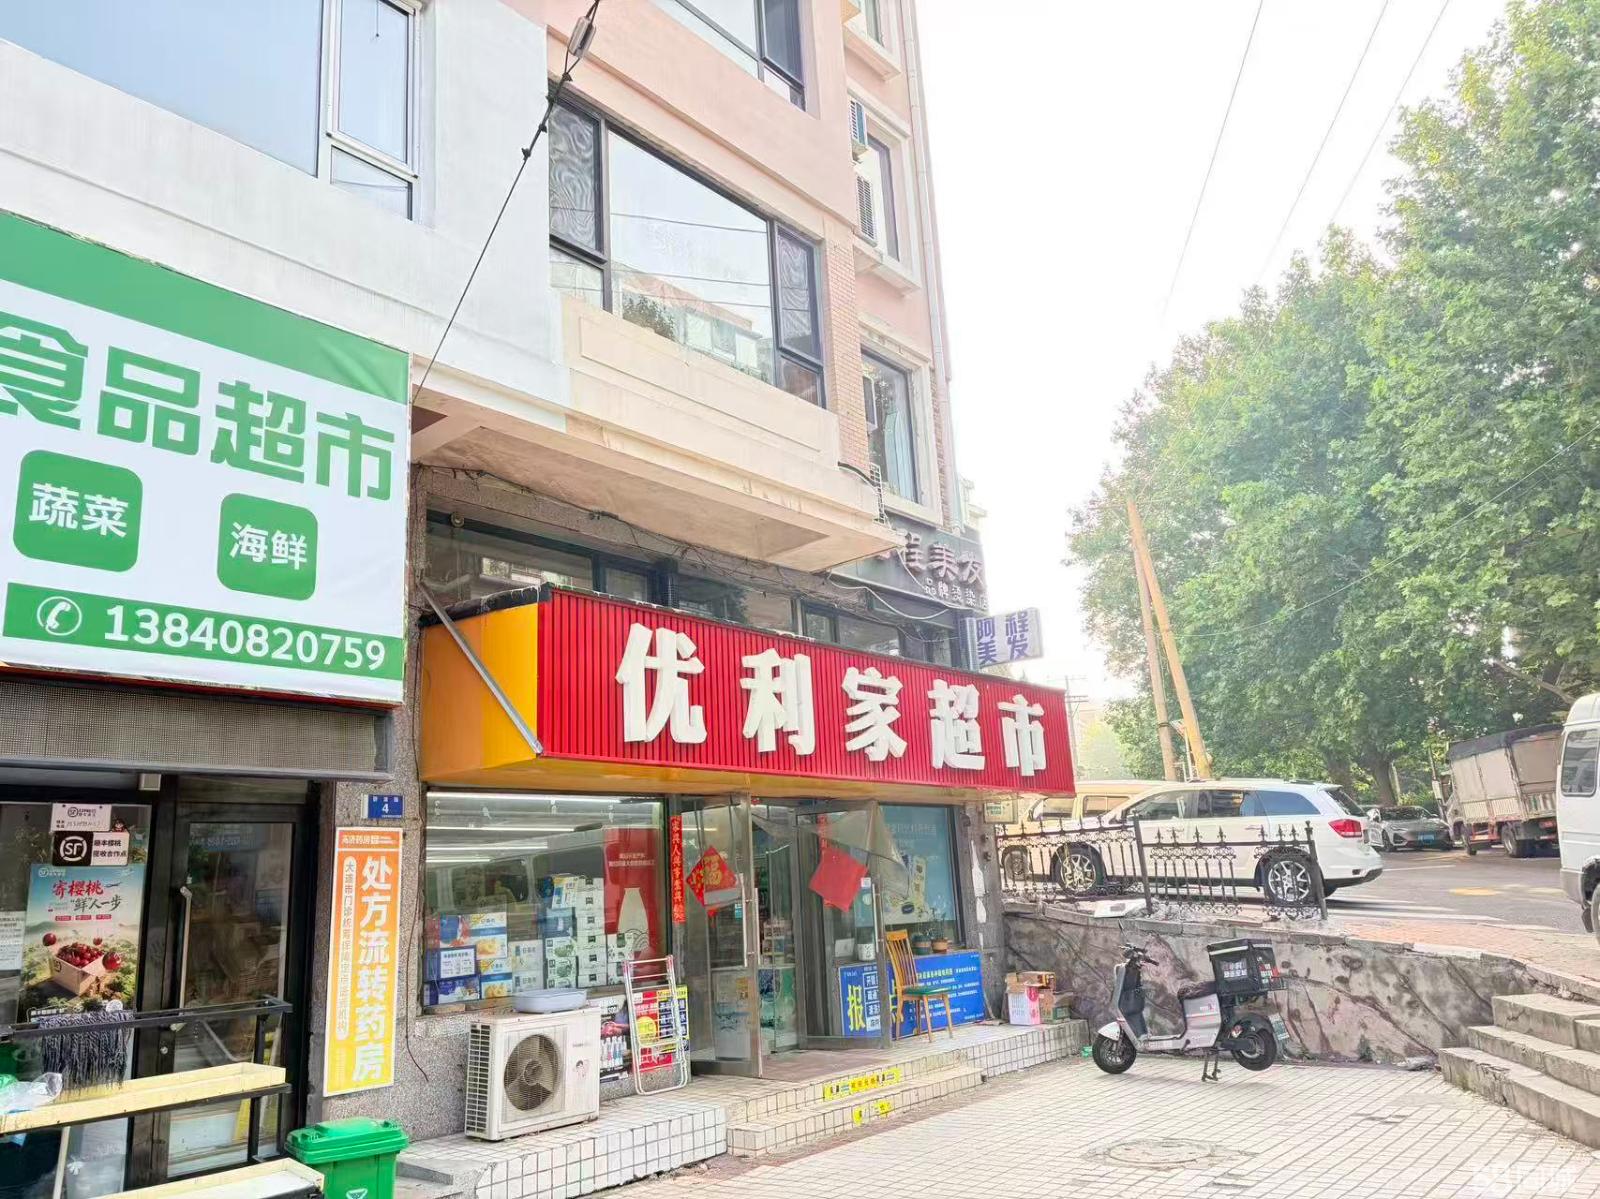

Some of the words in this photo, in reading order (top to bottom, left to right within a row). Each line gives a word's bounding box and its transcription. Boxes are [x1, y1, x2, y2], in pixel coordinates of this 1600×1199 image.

[0, 311, 395, 501] 食品超市
[28, 482, 129, 538] 蔬菜
[230, 521, 308, 571] 海鲜
[104, 604, 386, 672] 13840820759
[615, 622, 1047, 777] 优利家超市
[382, 803, 390, 814] 4
[52, 879, 104, 899] 寄樱桃
[352, 855, 393, 1082] 处方流转药房
[847, 983, 866, 1032] 报
